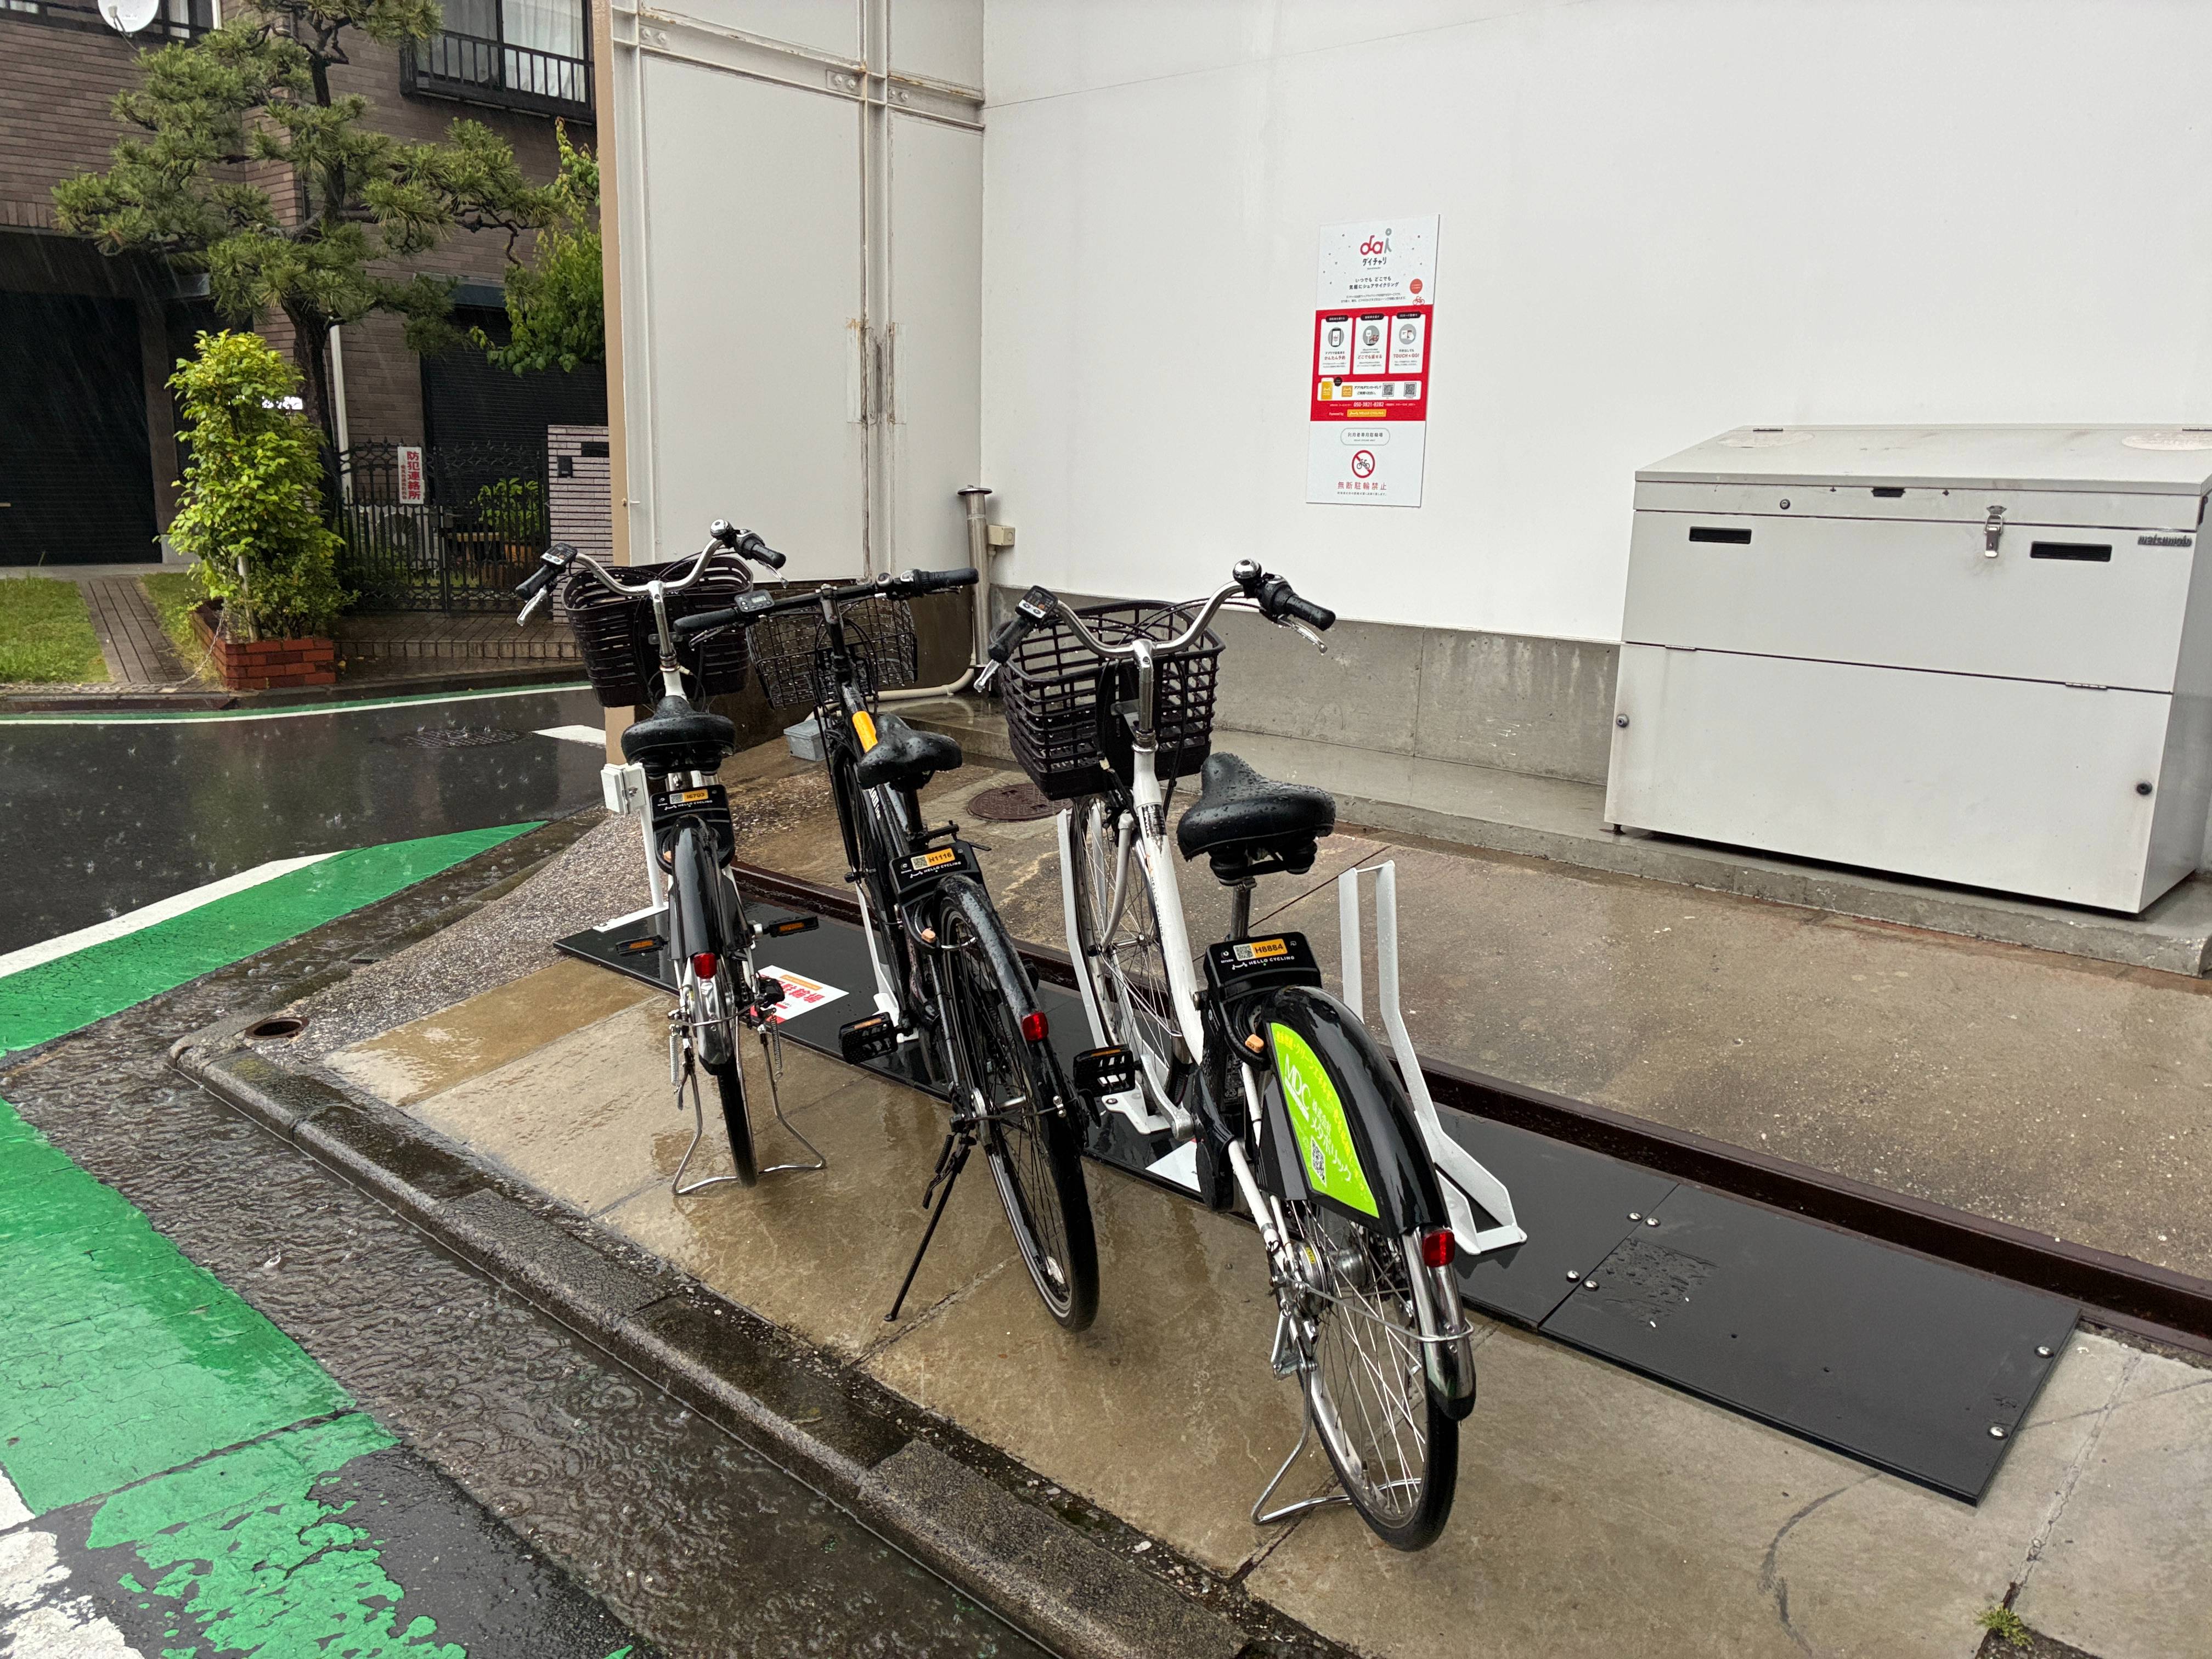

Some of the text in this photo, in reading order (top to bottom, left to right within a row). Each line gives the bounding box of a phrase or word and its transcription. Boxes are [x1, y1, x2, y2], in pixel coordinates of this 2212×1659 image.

[1360, 228, 1392, 255] dai
[1362, 257, 1387, 267] ダイチャリ
[407, 451, 421, 500] 防犯連絡所
[1338, 481, 1387, 490] 無断駐輪禁止
[2137, 534, 2192, 547] matsumoto
[928, 852, 952, 863] H1116
[1254, 943, 1284, 954] H8884
[1284, 1053, 1311, 1110] MDC
[1312, 1098, 1331, 1137] 株式会社
